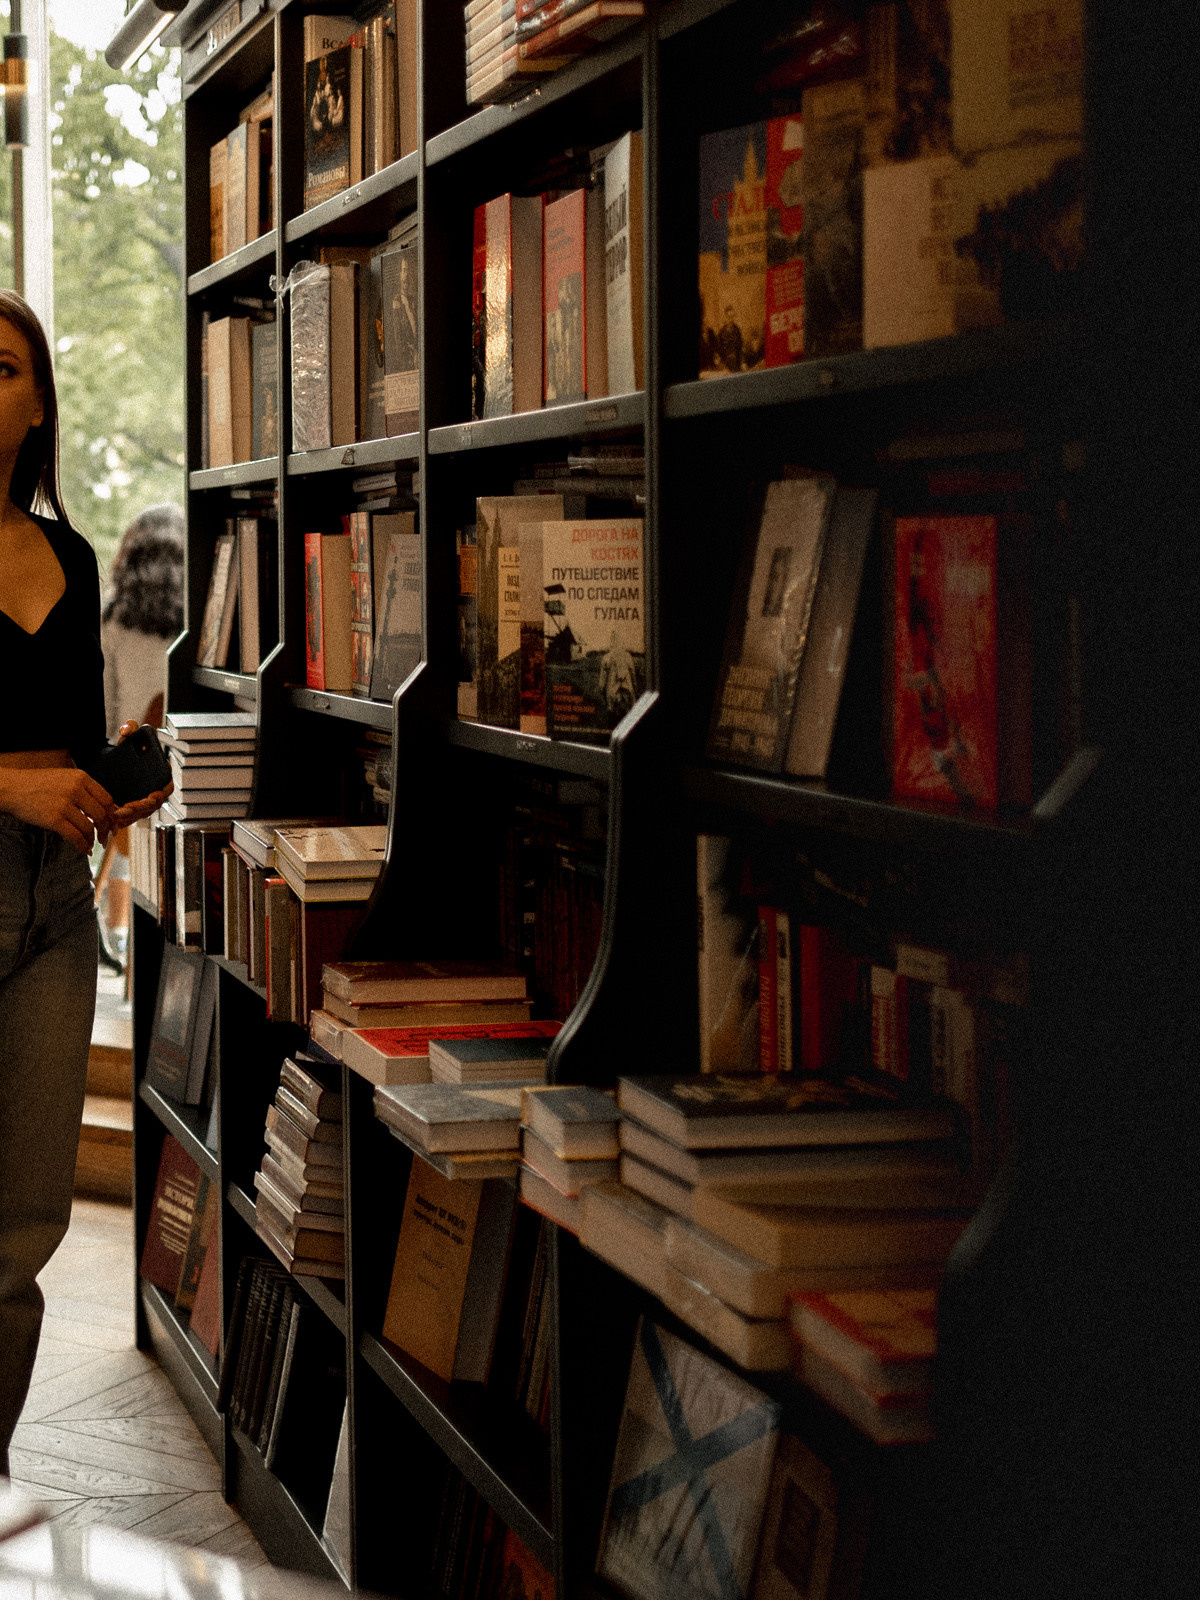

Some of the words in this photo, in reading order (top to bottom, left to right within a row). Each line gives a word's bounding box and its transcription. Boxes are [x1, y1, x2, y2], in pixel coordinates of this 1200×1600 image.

[571, 528, 619, 543] ДОРОГА
[621, 527, 639, 540] НА
[591, 547, 639, 561] КОСТЯХ
[552, 567, 640, 581] ПУТЕШЕСТВИЕ
[568, 587, 584, 600] ПО
[587, 587, 640, 603] СЛЕДАМ
[594, 607, 640, 620] ГУЛАГА
